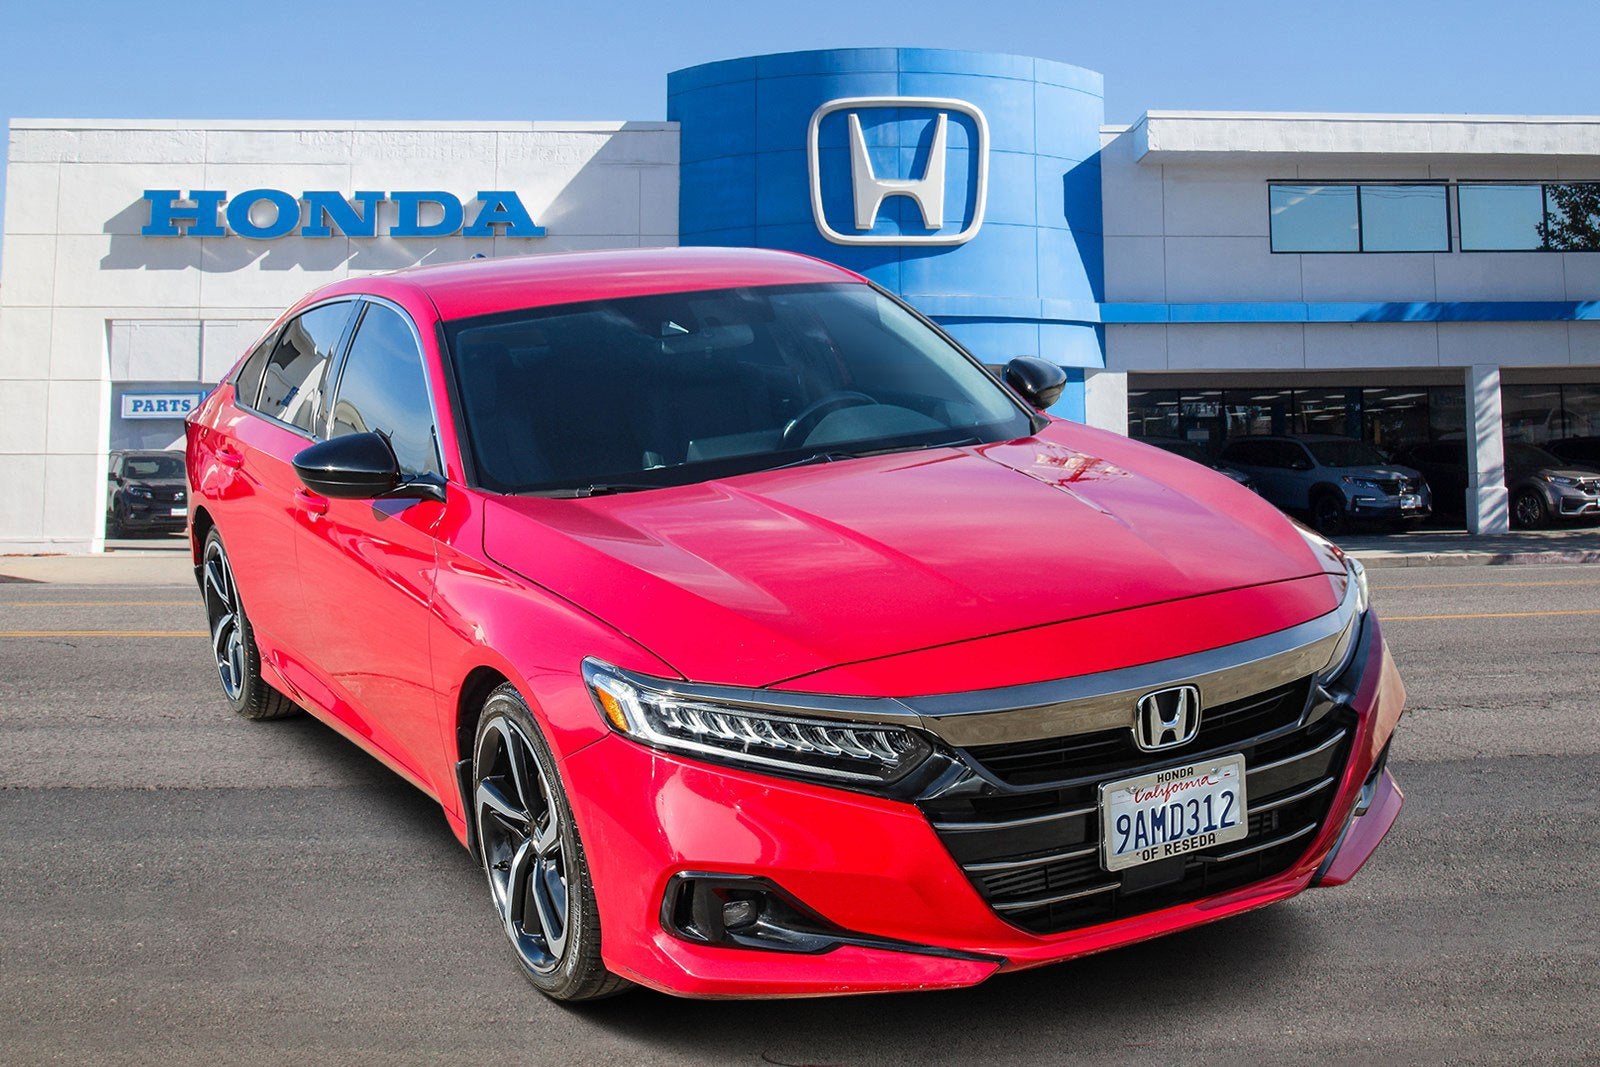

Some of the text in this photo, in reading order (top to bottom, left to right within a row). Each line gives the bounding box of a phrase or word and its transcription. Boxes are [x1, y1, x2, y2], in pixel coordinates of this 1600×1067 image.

[141, 188, 547, 240] HONDA
[132, 399, 191, 412] PARTS
[1157, 766, 1194, 783] HONDA
[1134, 775, 1218, 803] California
[1116, 790, 1236, 854] 9AMD312
[1142, 833, 1216, 861] OF RESEDA
